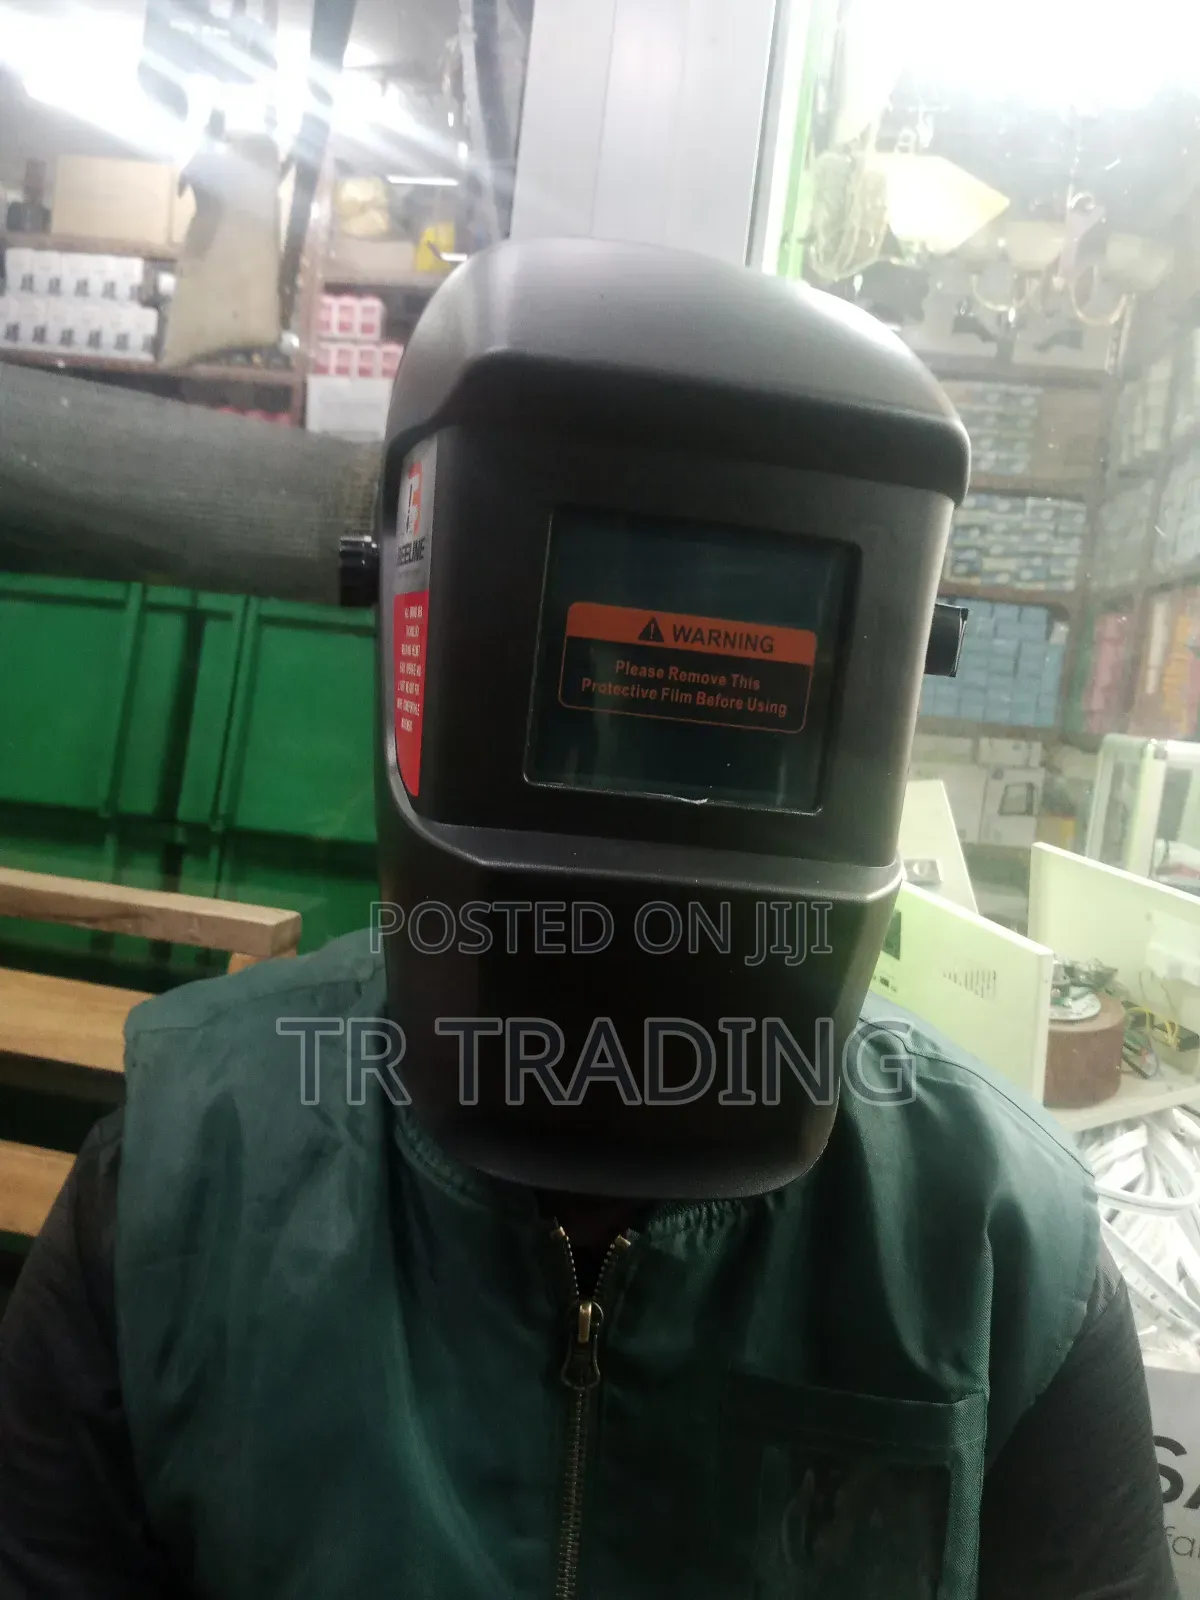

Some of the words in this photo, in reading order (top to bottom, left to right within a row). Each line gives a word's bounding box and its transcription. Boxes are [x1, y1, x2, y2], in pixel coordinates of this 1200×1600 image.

[672, 623, 775, 654] WARNING
[615, 659, 665, 680] Please
[668, 666, 727, 687] Remove
[731, 673, 761, 691] This
[581, 677, 658, 700] Protective
[661, 687, 693, 705] Film
[696, 691, 743, 711] Before
[747, 697, 788, 718] Using
